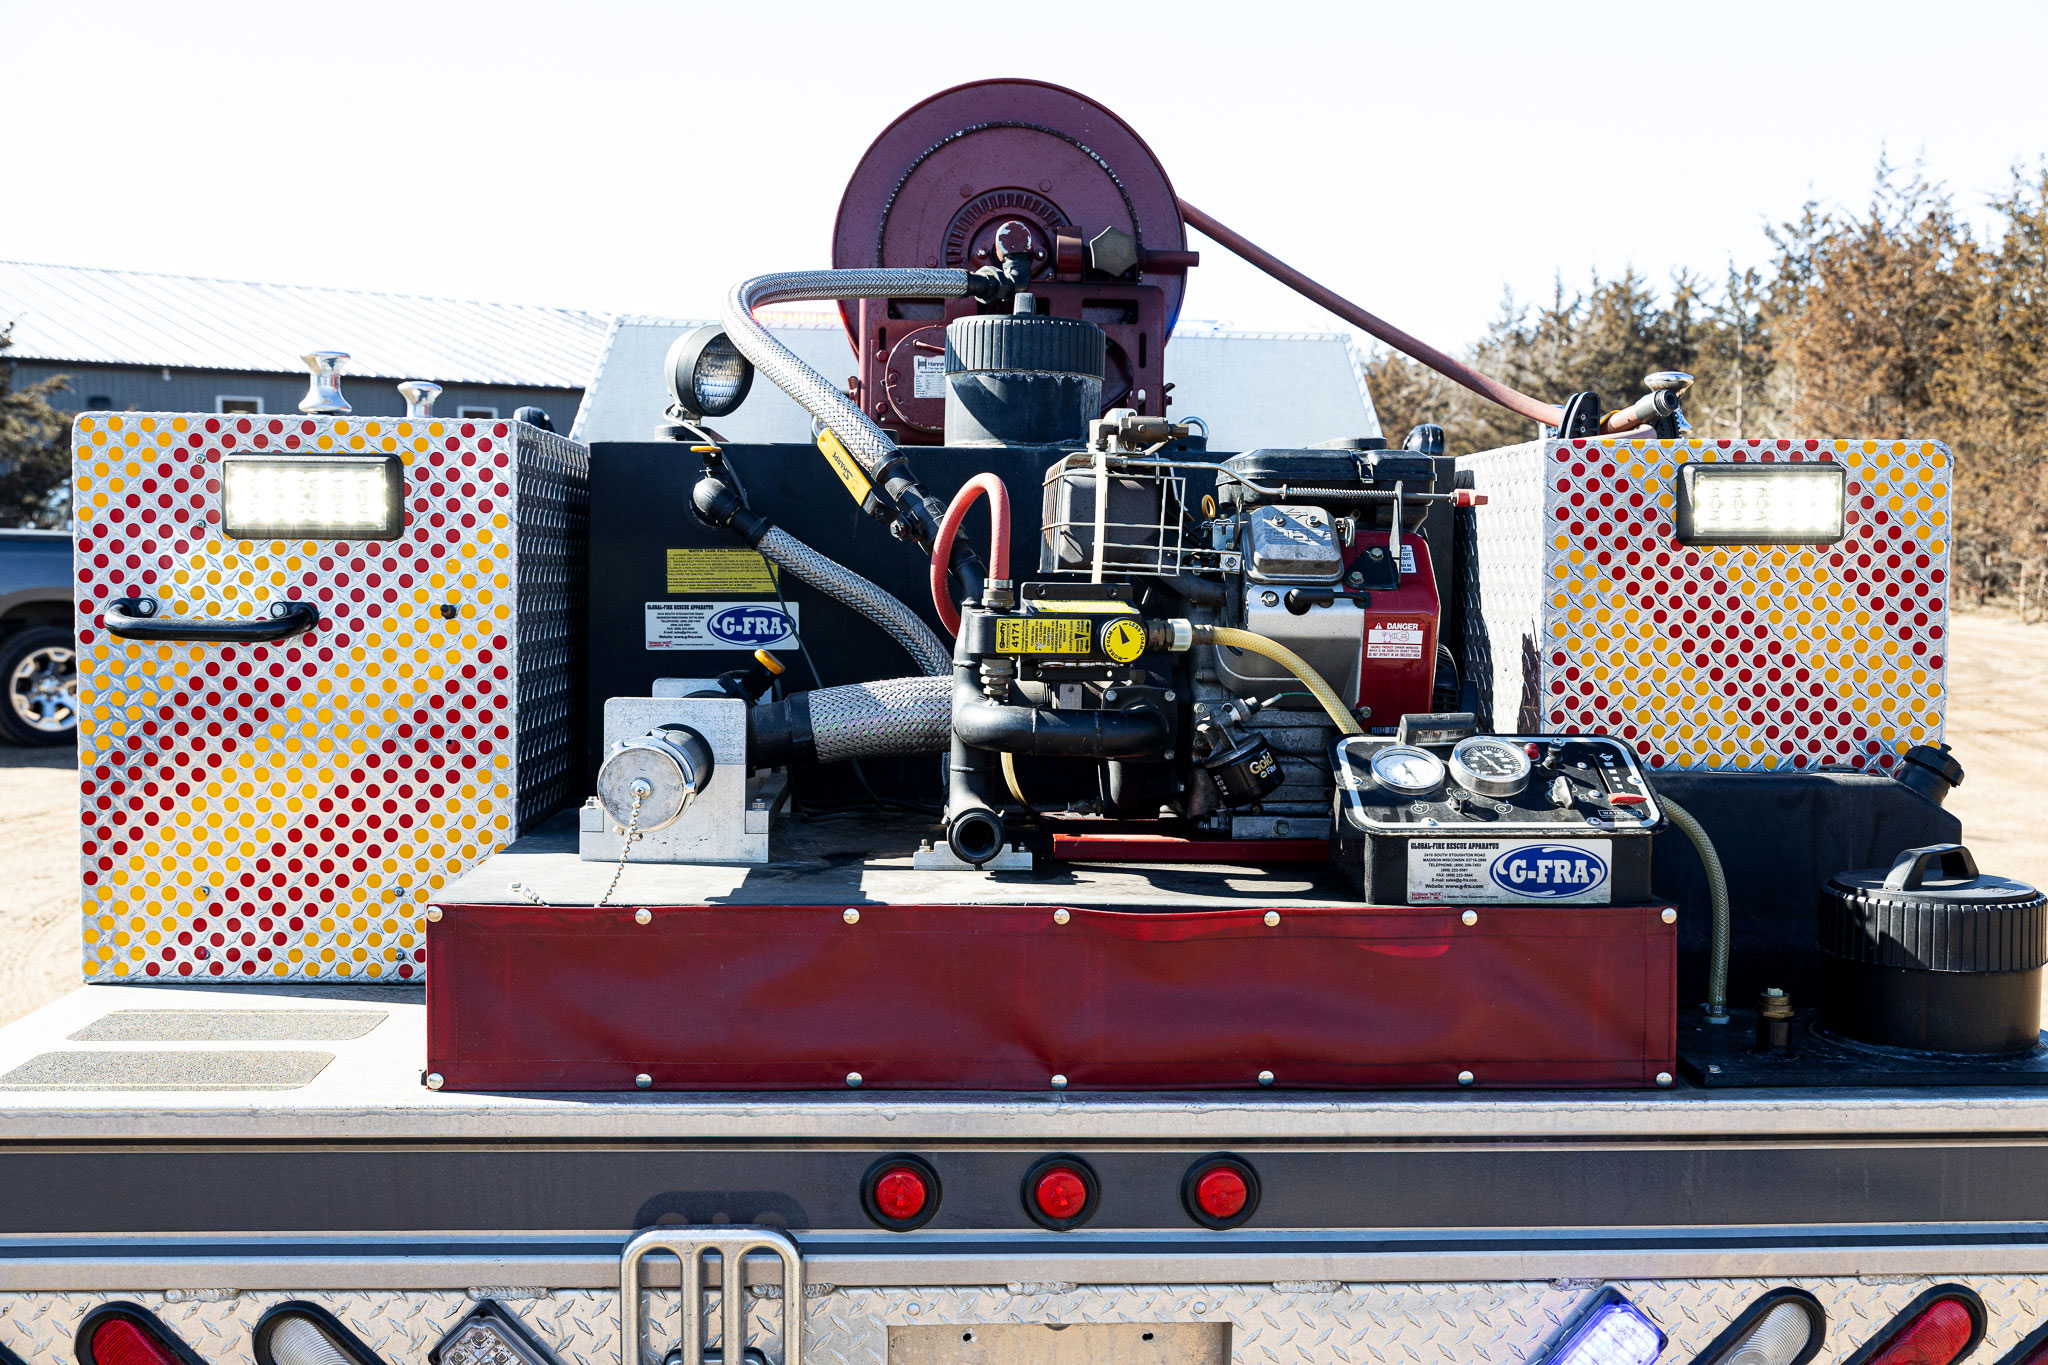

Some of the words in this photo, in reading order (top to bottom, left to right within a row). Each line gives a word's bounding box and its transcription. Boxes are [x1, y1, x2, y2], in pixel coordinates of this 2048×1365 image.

[832, 451, 854, 480] SHARPE
[722, 616, 782, 635] G-FRA
[1128, 622, 1141, 633] LESS
[1109, 648, 1123, 661] MORE
[1250, 752, 1274, 775] Gold
[1509, 860, 1590, 884] G-FRA
